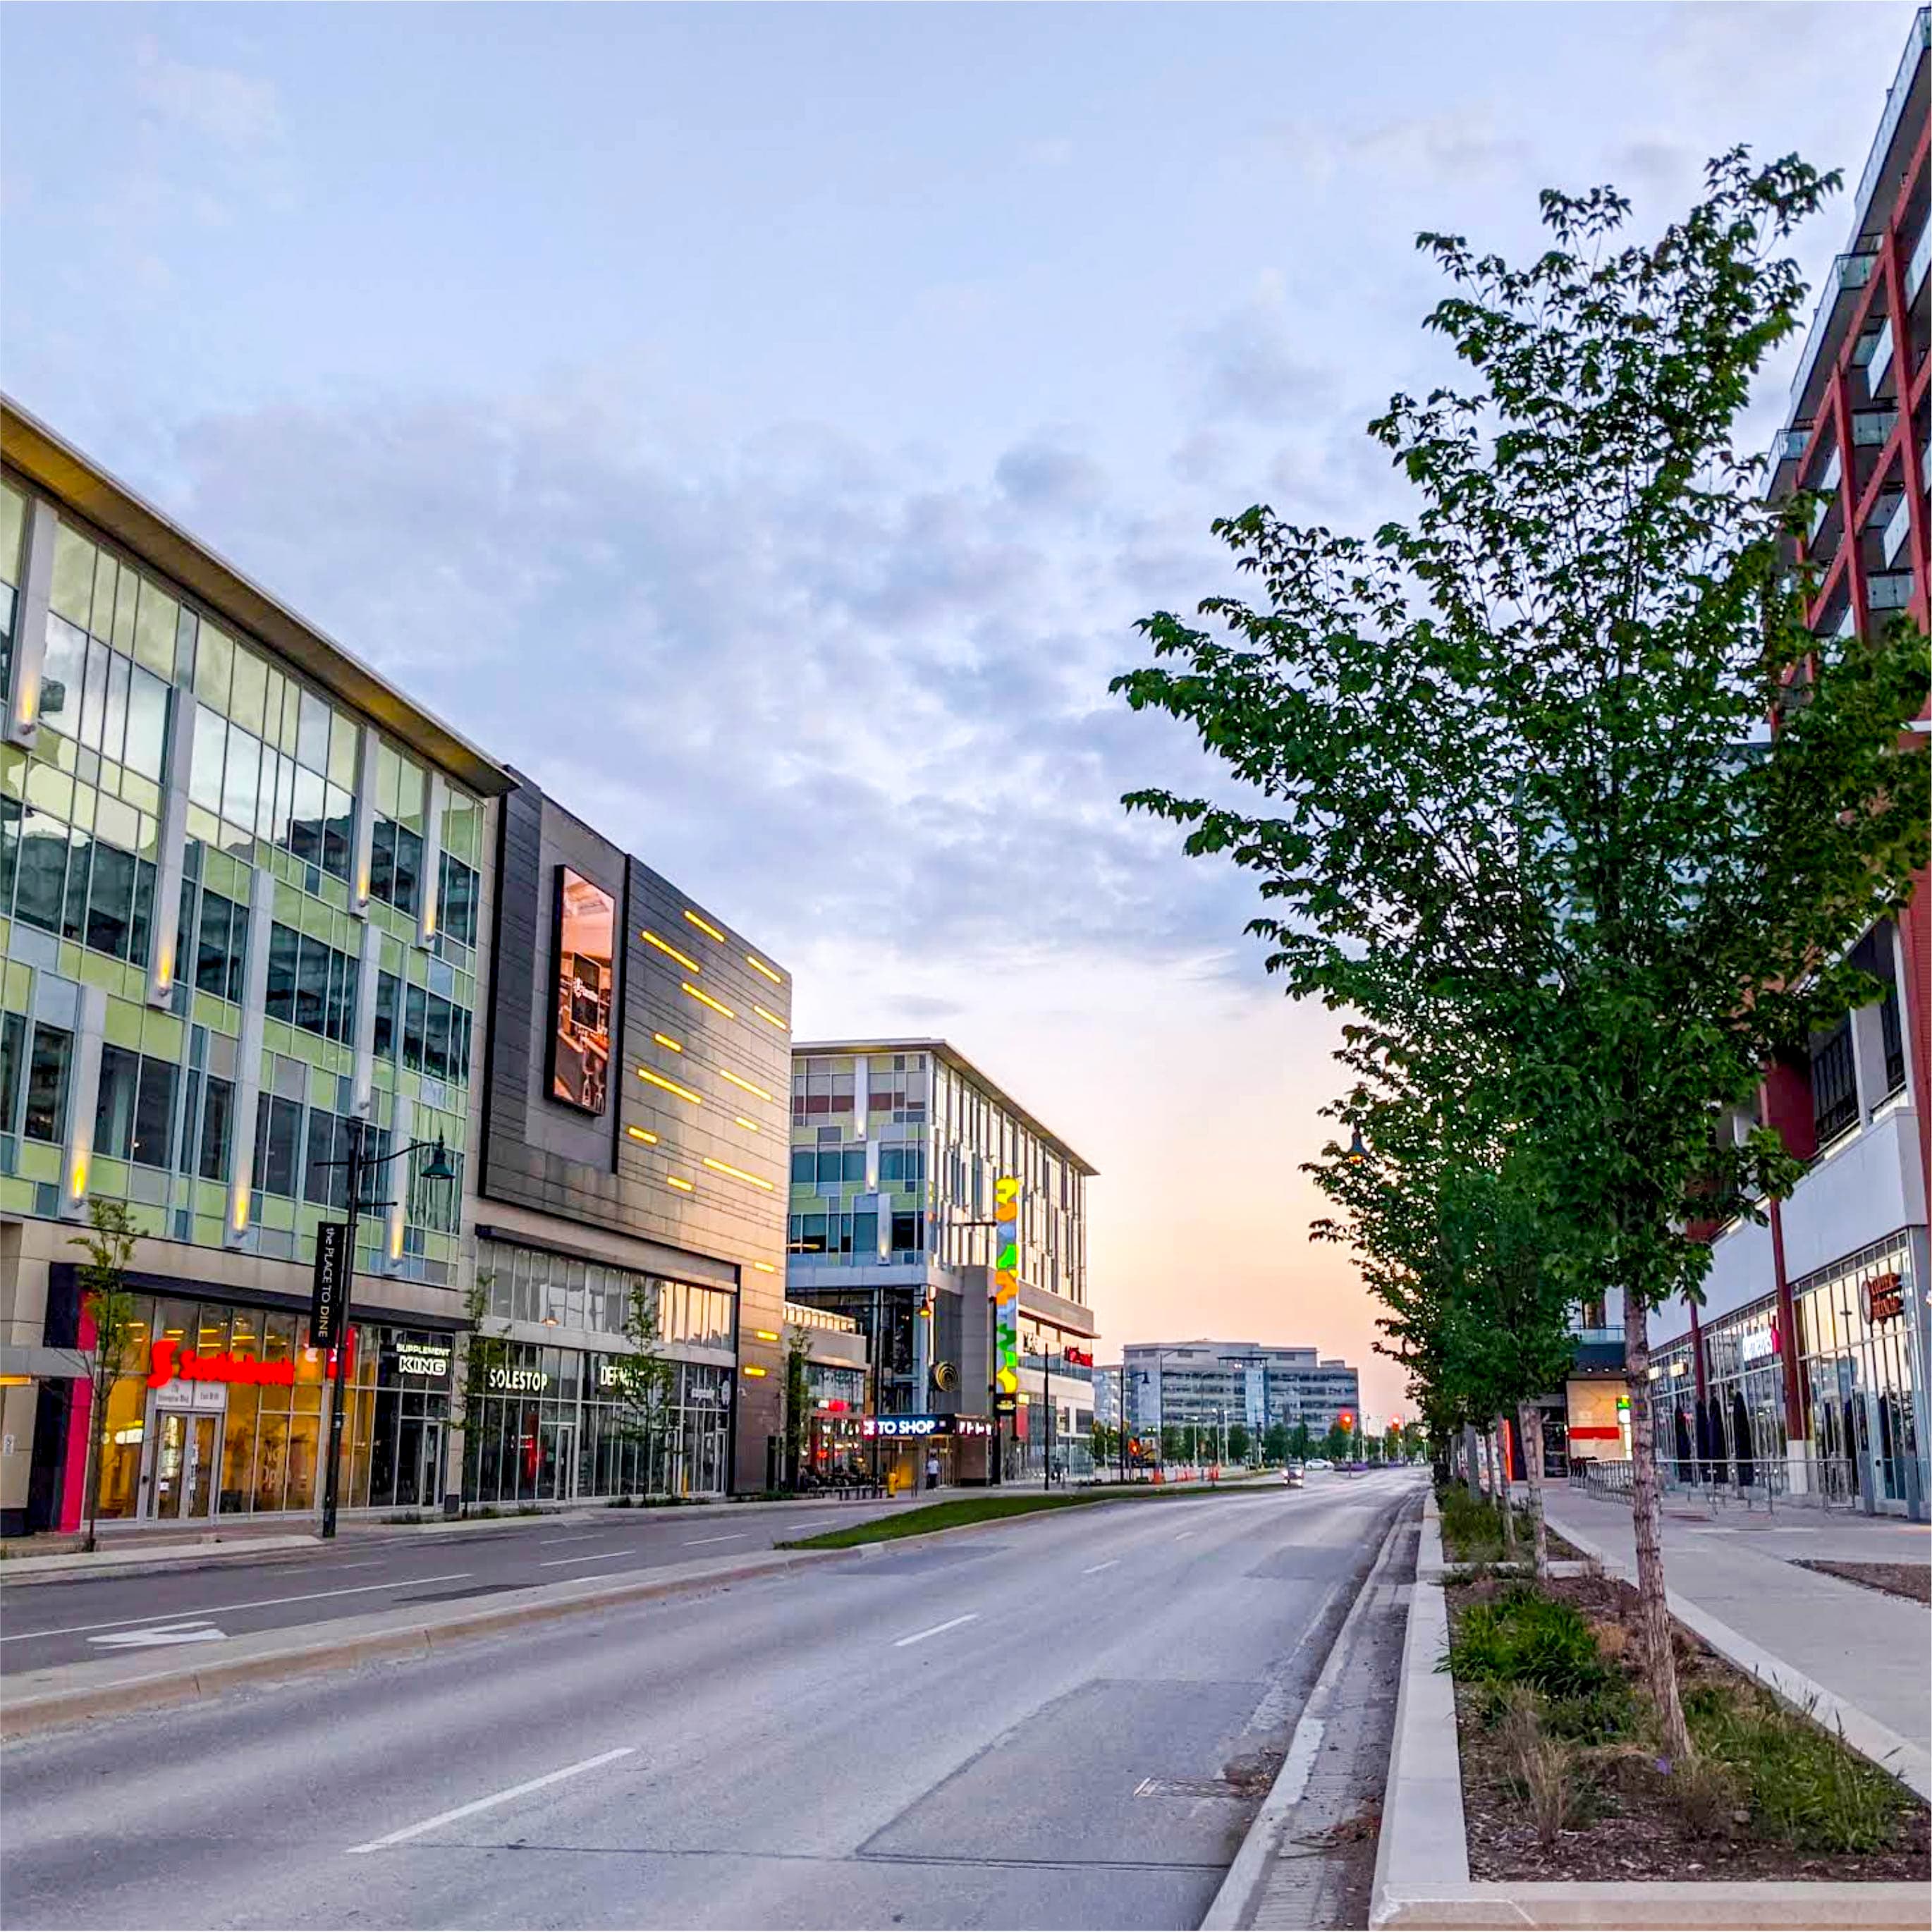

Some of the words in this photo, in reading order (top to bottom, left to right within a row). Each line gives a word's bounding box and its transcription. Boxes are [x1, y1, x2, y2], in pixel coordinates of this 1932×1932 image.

[325, 1228, 335, 1245] the
[322, 1247, 335, 1283] PLACE
[322, 1286, 331, 1303] TO
[318, 1306, 329, 1338] DINE
[396, 1343, 451, 1357] SUPPLEMENT
[399, 1355, 446, 1376] KING
[489, 1368, 548, 1392] SOLESTOP
[878, 1420, 896, 1435] TO
[899, 1419, 935, 1434] SHOP
